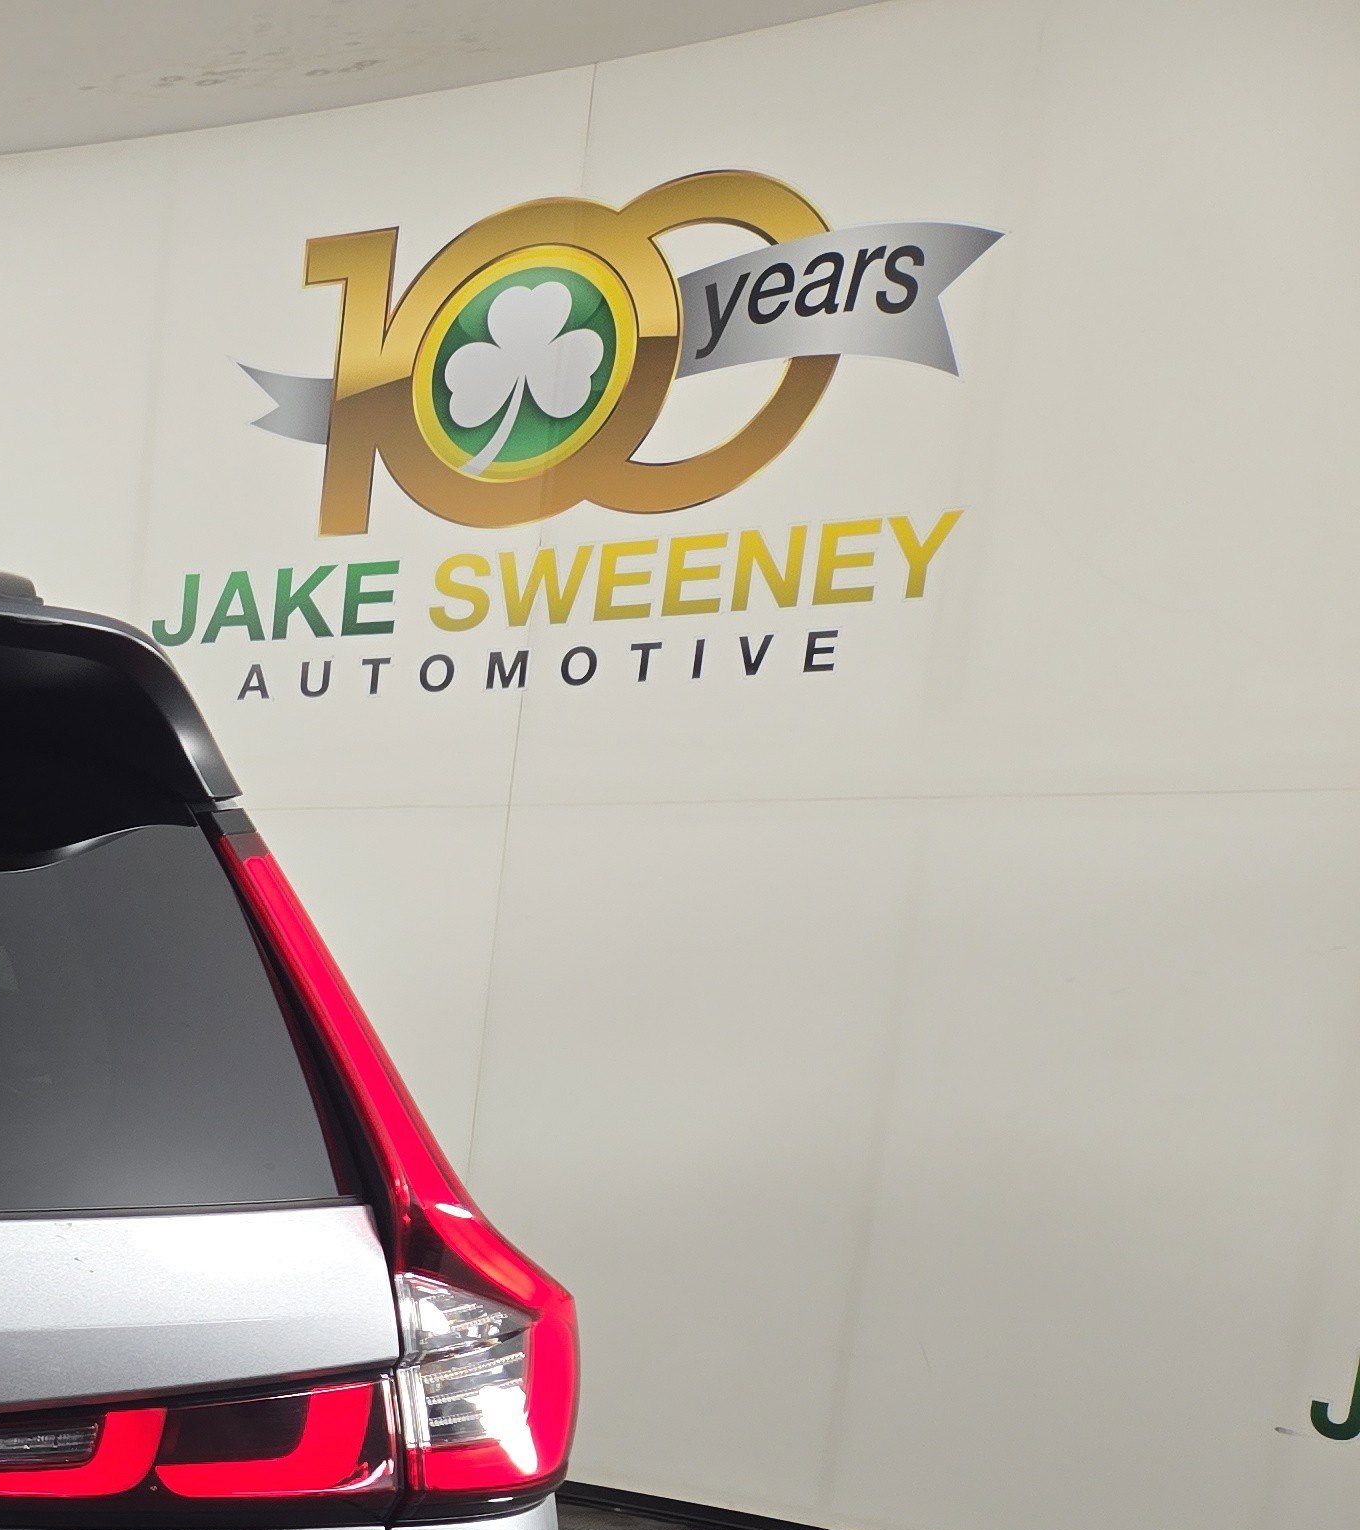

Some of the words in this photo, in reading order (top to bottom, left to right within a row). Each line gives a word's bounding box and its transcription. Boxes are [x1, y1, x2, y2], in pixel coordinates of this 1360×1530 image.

[694, 242, 925, 361] years
[152, 560, 401, 647] JAKE
[428, 510, 964, 632] SWEENEY
[236, 630, 840, 701] AUTOMOTIVE
